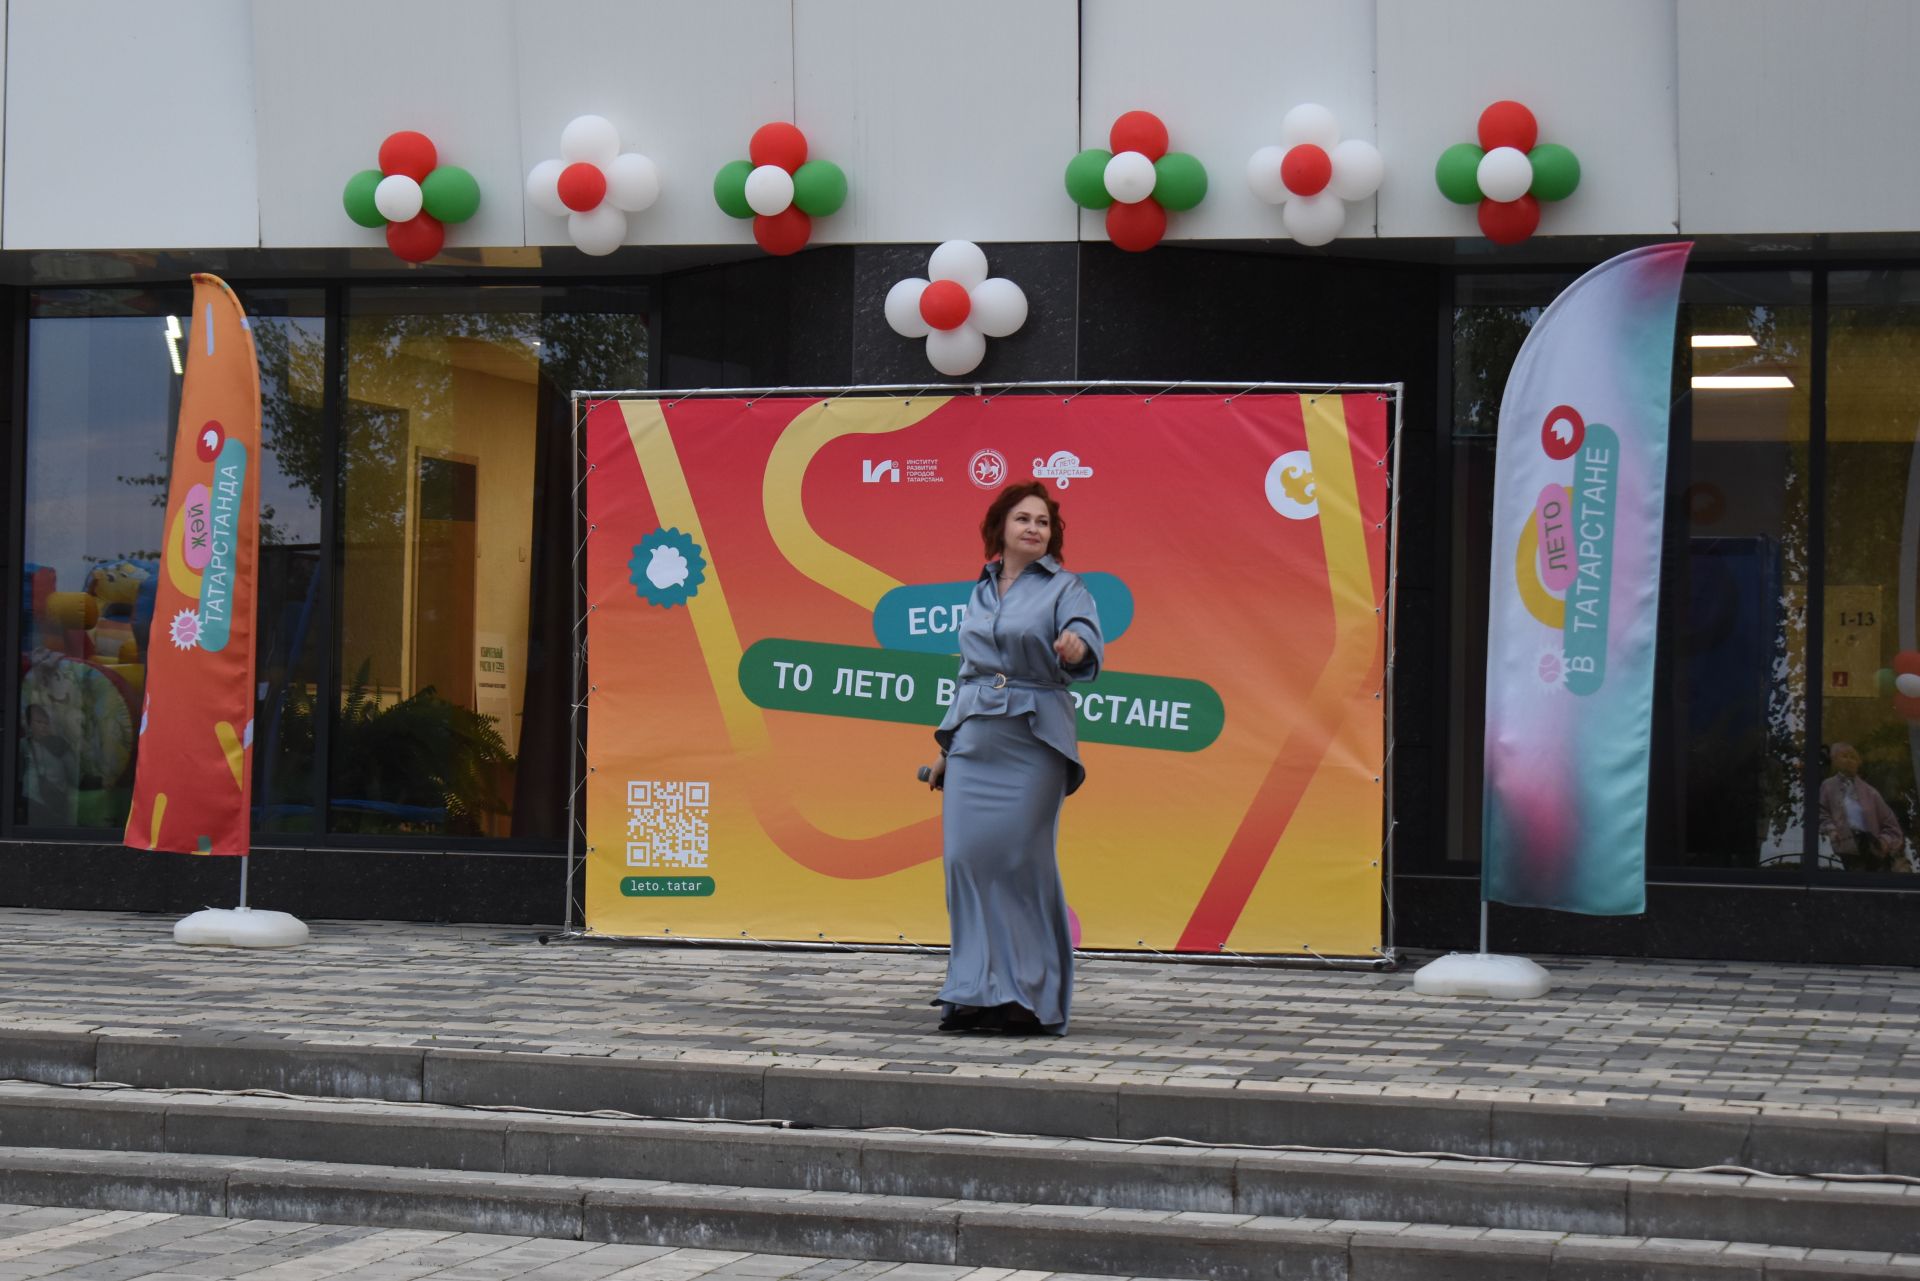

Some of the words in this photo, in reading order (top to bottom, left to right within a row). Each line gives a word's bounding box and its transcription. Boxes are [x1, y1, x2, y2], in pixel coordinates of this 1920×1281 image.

[204, 465, 239, 625] ТАТАРСТАНДА
[1543, 501, 1568, 571] ЛЕТО
[1573, 447, 1609, 633] ТАТАРСТАНЕ
[908, 604, 968, 635] ЕСЛ
[773, 661, 813, 692] ТО
[832, 667, 915, 702] ЛЕТО
[935, 678, 956, 706] В
[1069, 691, 1192, 731] РСТАНЕ
[1571, 655, 1595, 673] В
[630, 880, 702, 891] leto.tatar
